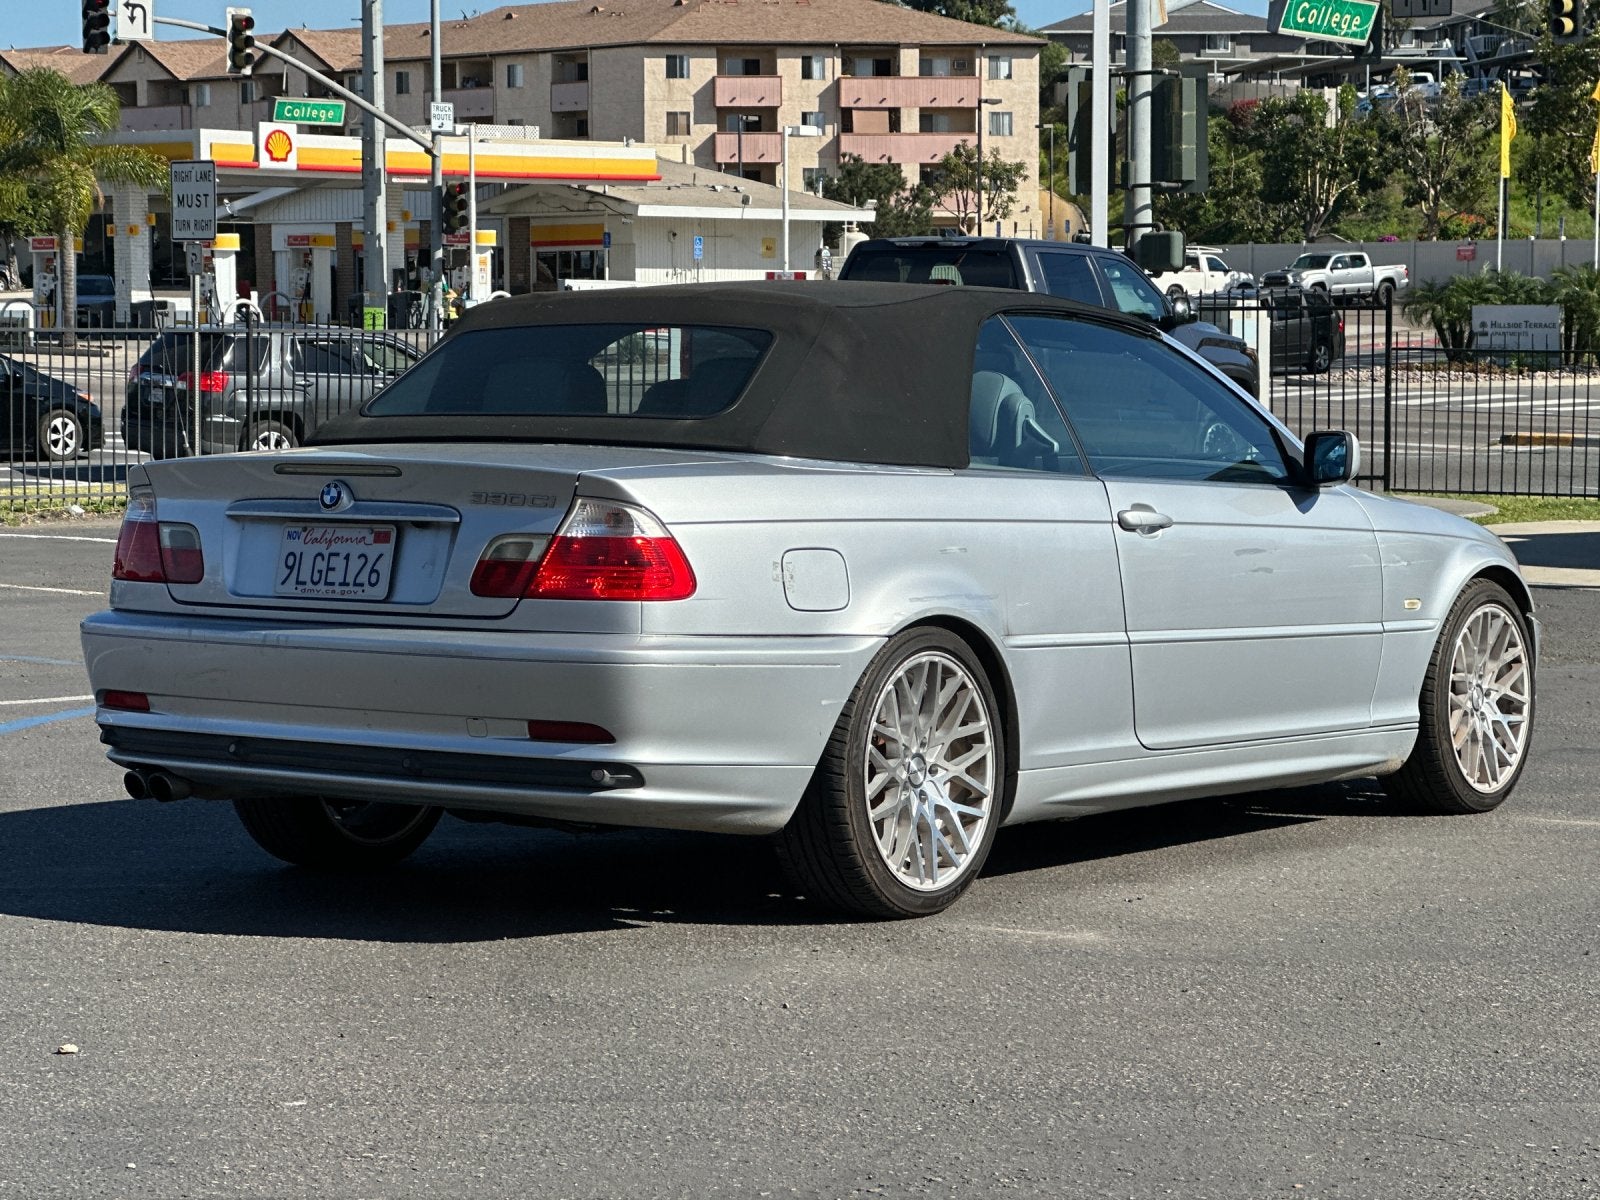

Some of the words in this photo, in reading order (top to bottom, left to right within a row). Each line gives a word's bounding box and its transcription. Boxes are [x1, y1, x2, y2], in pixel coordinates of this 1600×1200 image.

[1296, 1, 1361, 36] College
[284, 105, 334, 122] College
[432, 104, 452, 112] TRUCK
[432, 113, 452, 121] ROUTE
[173, 170, 193, 182] RIGHT
[195, 170, 212, 182] LANE
[177, 193, 210, 209] MUST
[175, 219, 191, 232] TURN
[193, 219, 213, 232] RIGHT
[1523, 320, 1557, 329] TERRACE
[286, 530, 303, 541] NOV
[303, 527, 373, 550] California
[280, 551, 385, 588] 9LGE126
[300, 587, 359, 596] dmv.ca.gov
